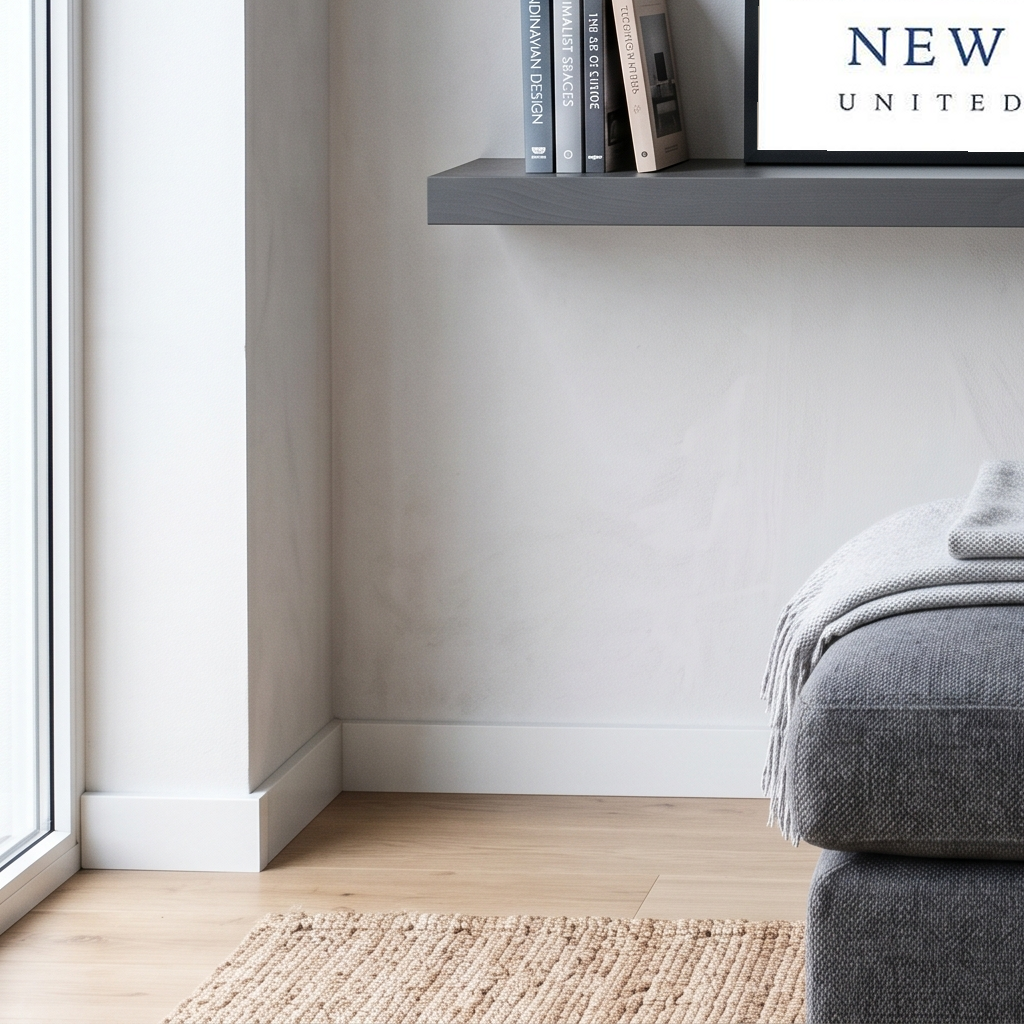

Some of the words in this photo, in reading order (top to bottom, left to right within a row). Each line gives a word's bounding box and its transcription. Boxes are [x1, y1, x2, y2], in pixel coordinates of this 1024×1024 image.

[848, 27, 1006, 67] NEW
[530, 74, 543, 125] DESIGN
[838, 93, 1022, 112] UNITED
